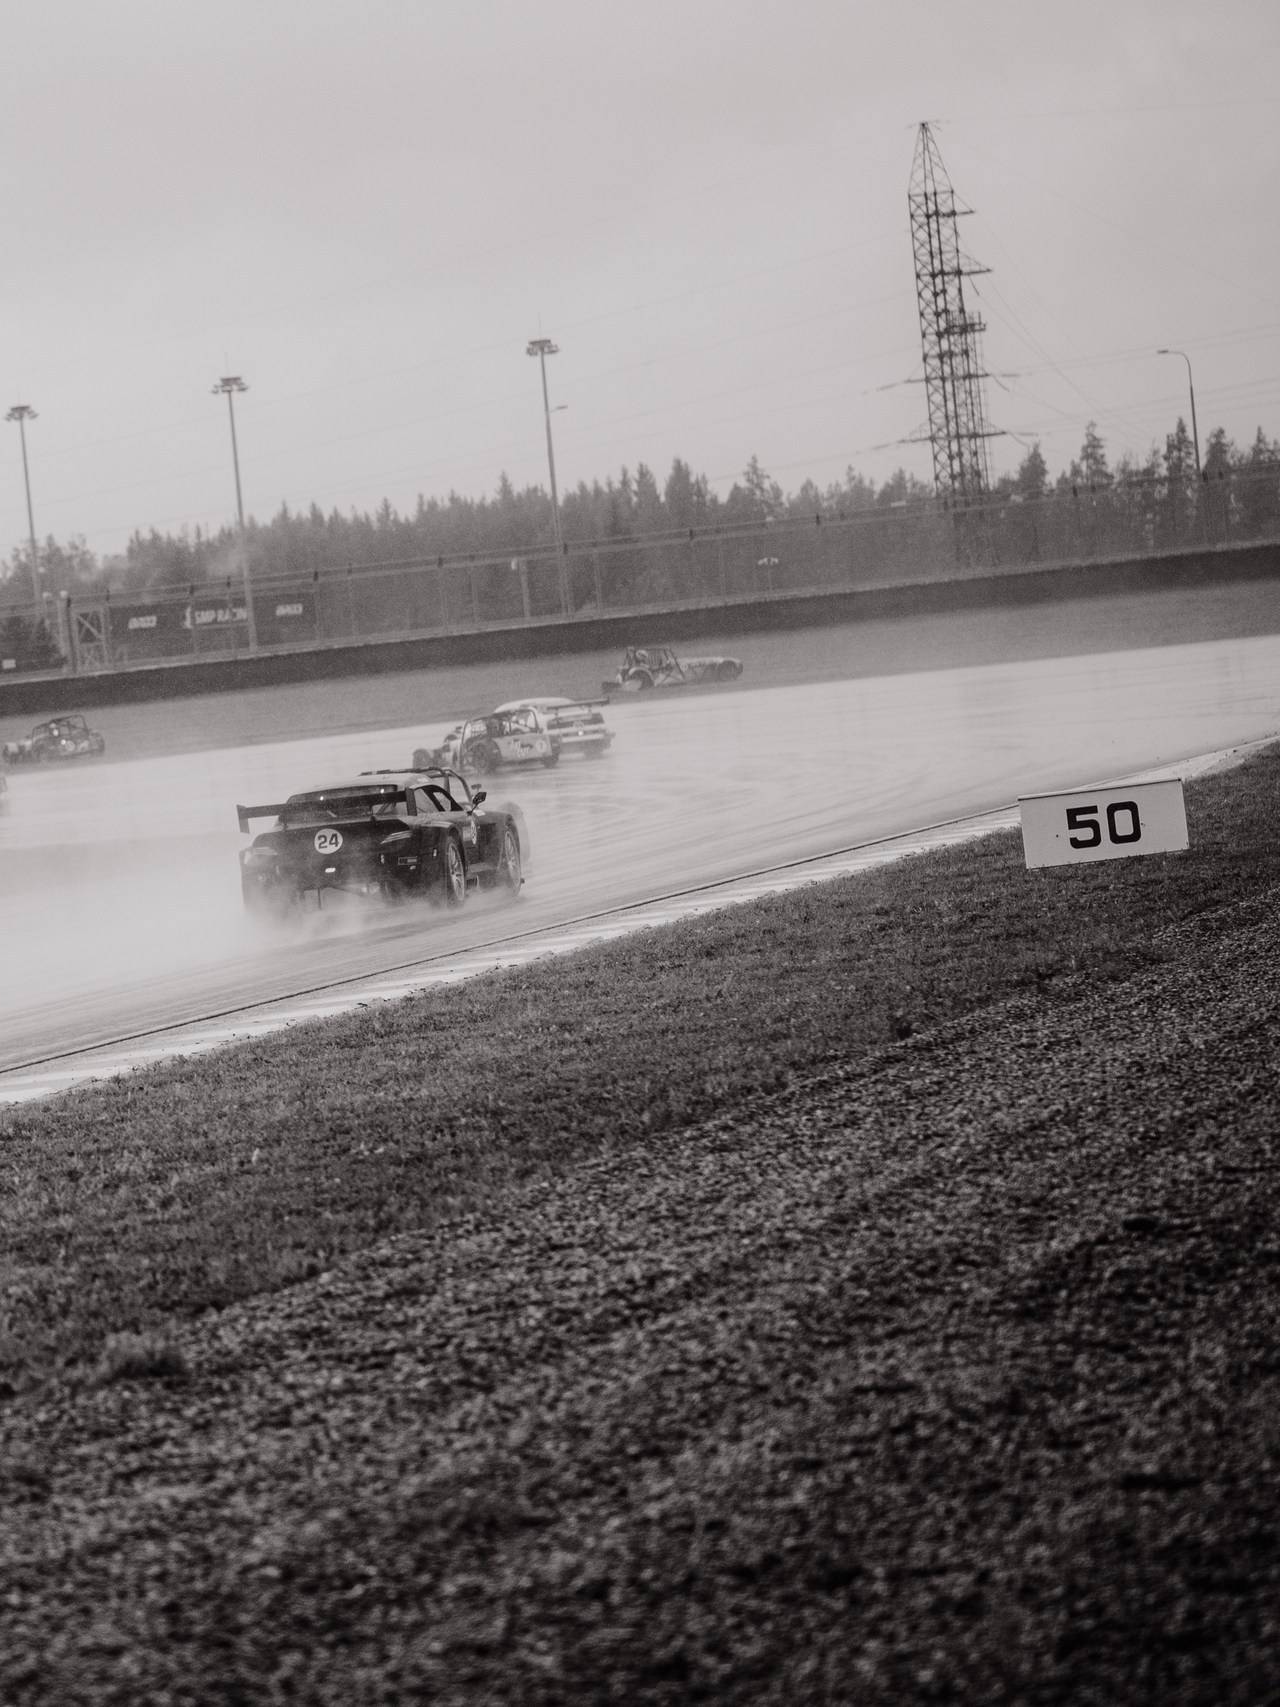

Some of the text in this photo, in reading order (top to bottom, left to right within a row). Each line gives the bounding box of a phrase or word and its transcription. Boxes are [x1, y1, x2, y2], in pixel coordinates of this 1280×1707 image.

[217, 607, 248, 622] RAIN
[1066, 801, 1142, 849] 50
[318, 833, 339, 849] 24
